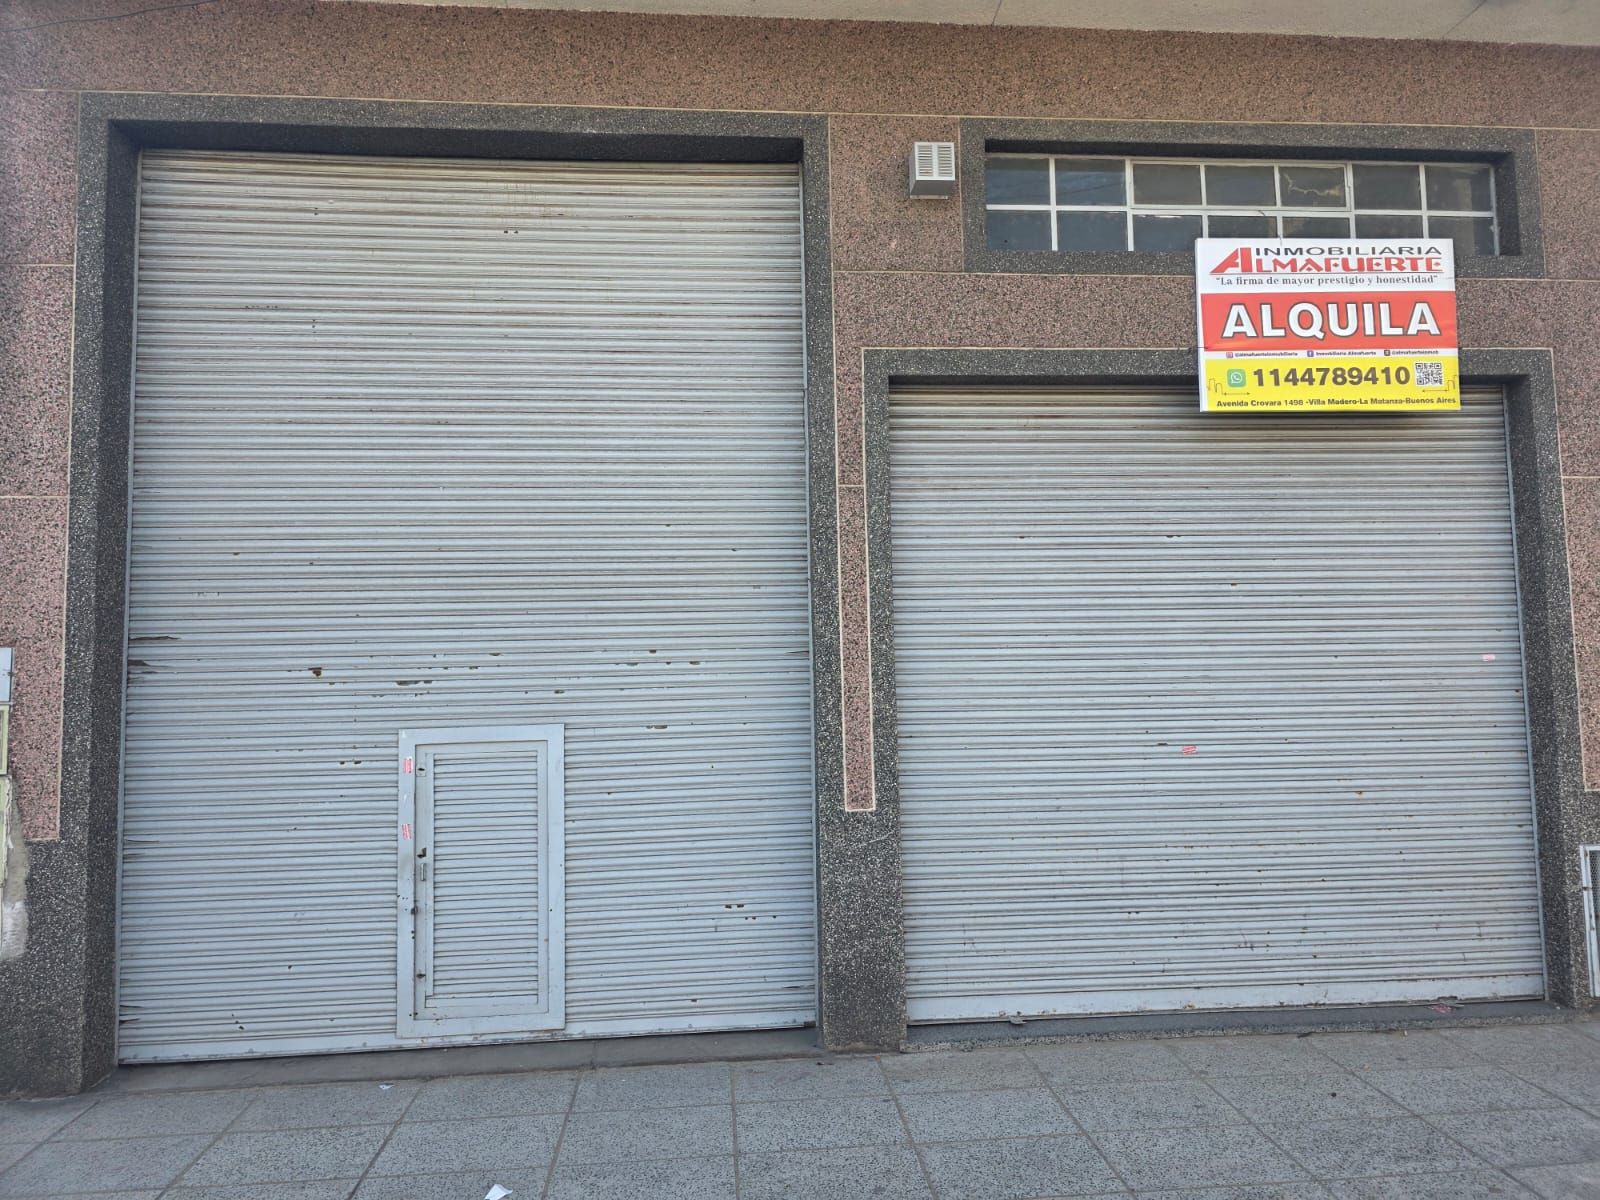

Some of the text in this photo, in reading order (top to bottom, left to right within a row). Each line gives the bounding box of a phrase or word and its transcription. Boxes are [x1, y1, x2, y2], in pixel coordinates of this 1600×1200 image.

[1209, 247, 1443, 273] ALMAFUERTE
[1255, 246, 1442, 256] INMOBILIARIA
[1236, 276, 1264, 285] firma
[1266, 276, 1279, 285] de
[1282, 278, 1315, 287] mayor
[1318, 275, 1365, 286] prestigio
[1367, 277, 1372, 286] y
[1376, 275, 1438, 284] honestidad"
[1221, 301, 1442, 340] ALQUILA
[1253, 366, 1411, 387] 1144789410
